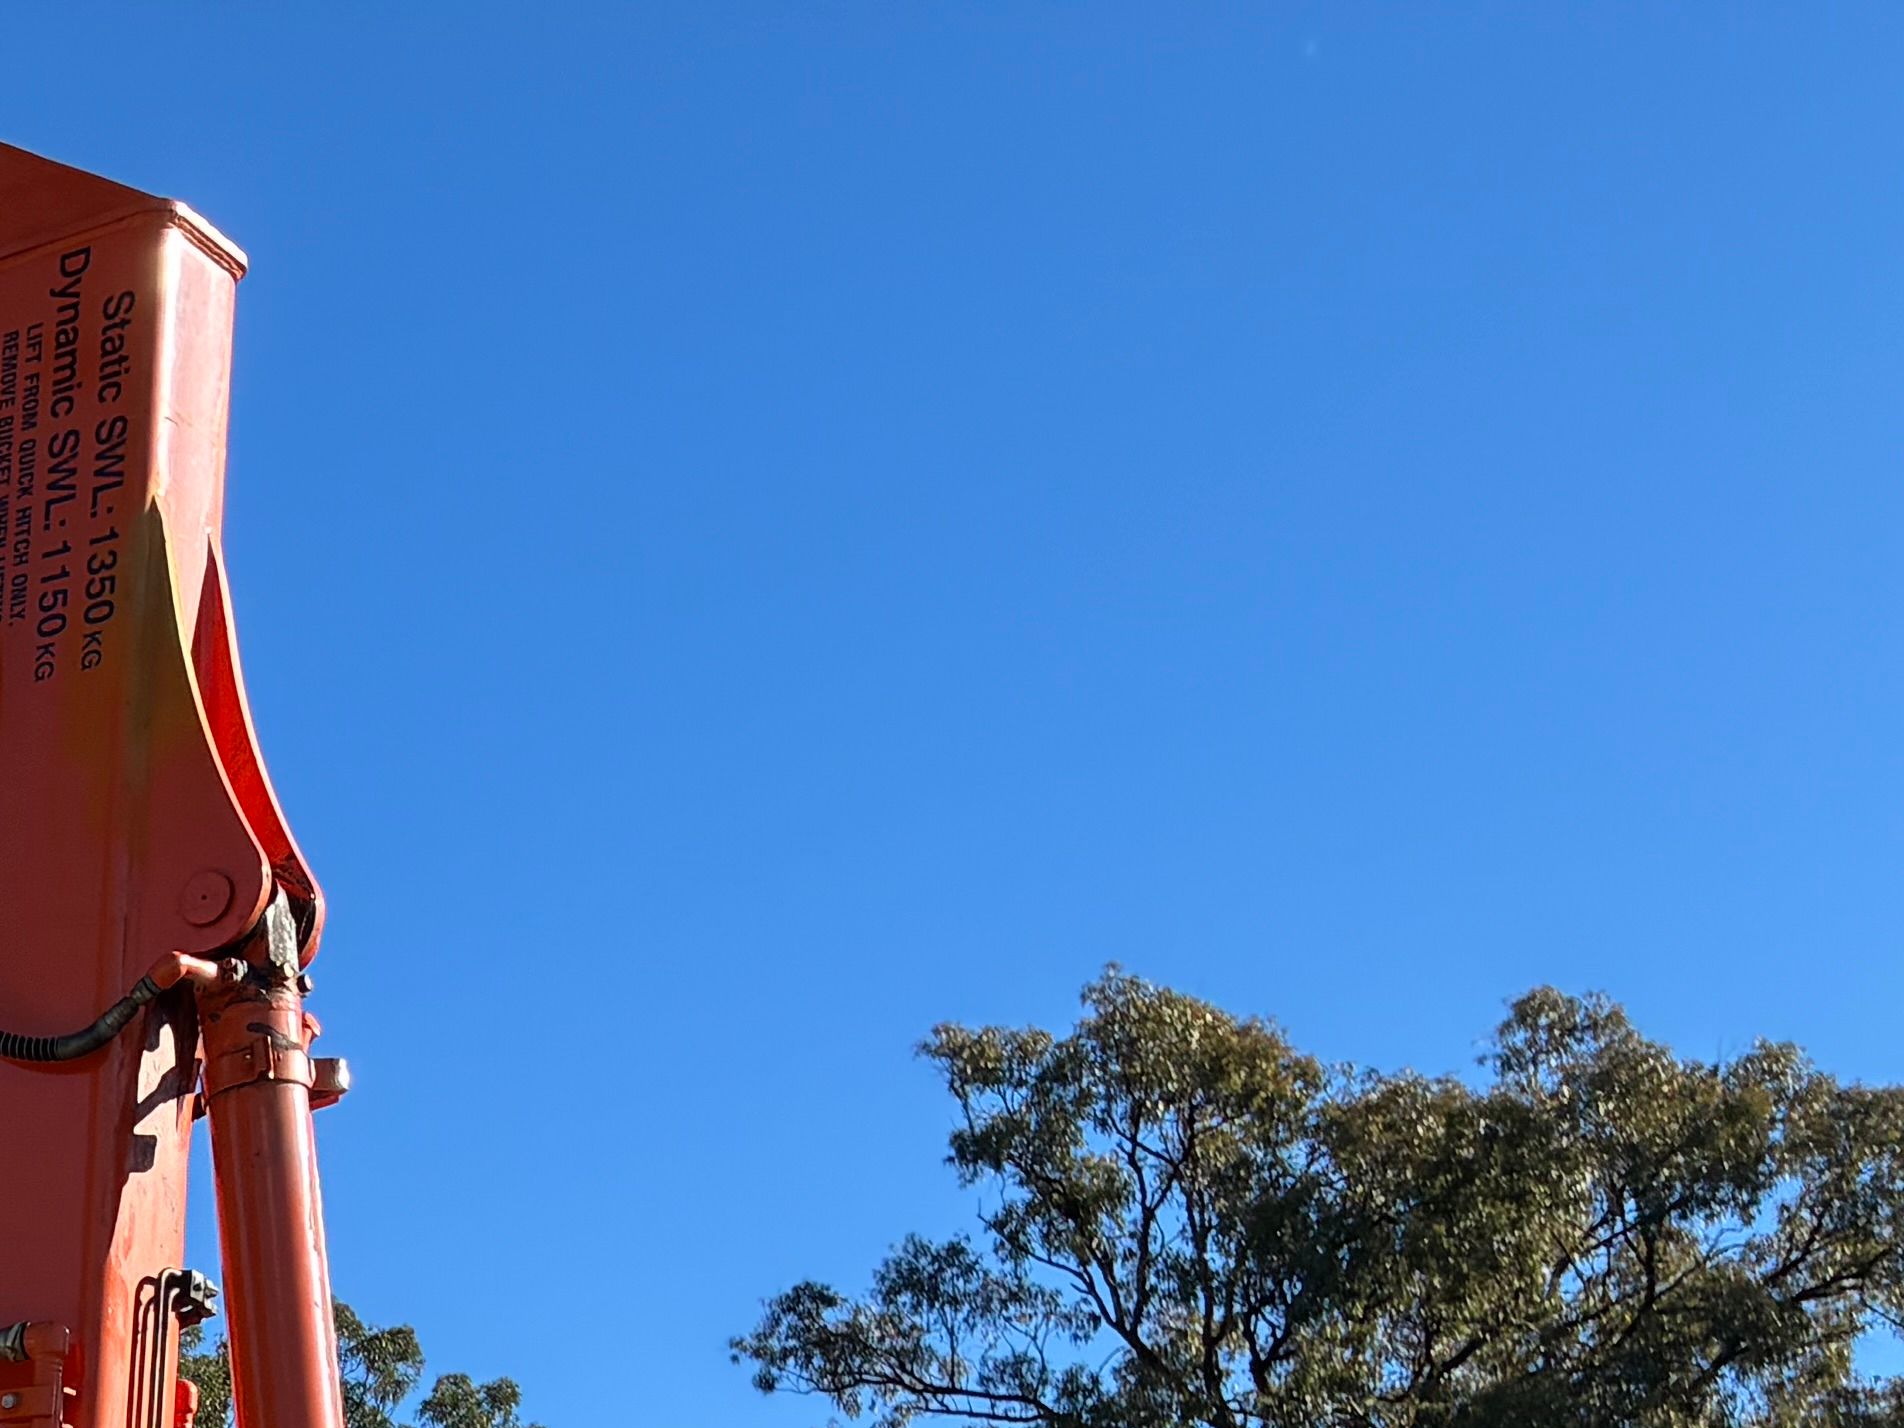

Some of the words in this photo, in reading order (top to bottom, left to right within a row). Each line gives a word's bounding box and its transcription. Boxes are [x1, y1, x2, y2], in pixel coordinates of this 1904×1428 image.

[25, 322, 44, 363] LIFT
[49, 246, 91, 418] Dynamic
[98, 290, 135, 404] Static
[0, 329, 19, 410] REMOVE
[21, 372, 40, 431] FROM
[16, 438, 36, 500] QUICK
[43, 429, 80, 531] SWL:
[90, 415, 128, 518] SWL:
[13, 506, 32, 566] HITCH
[8, 573, 28, 626] ONLY.
[37, 540, 71, 637] 1150
[84, 526, 119, 624] 1350
[34, 642, 55, 682] KG
[81, 630, 104, 671] KG
